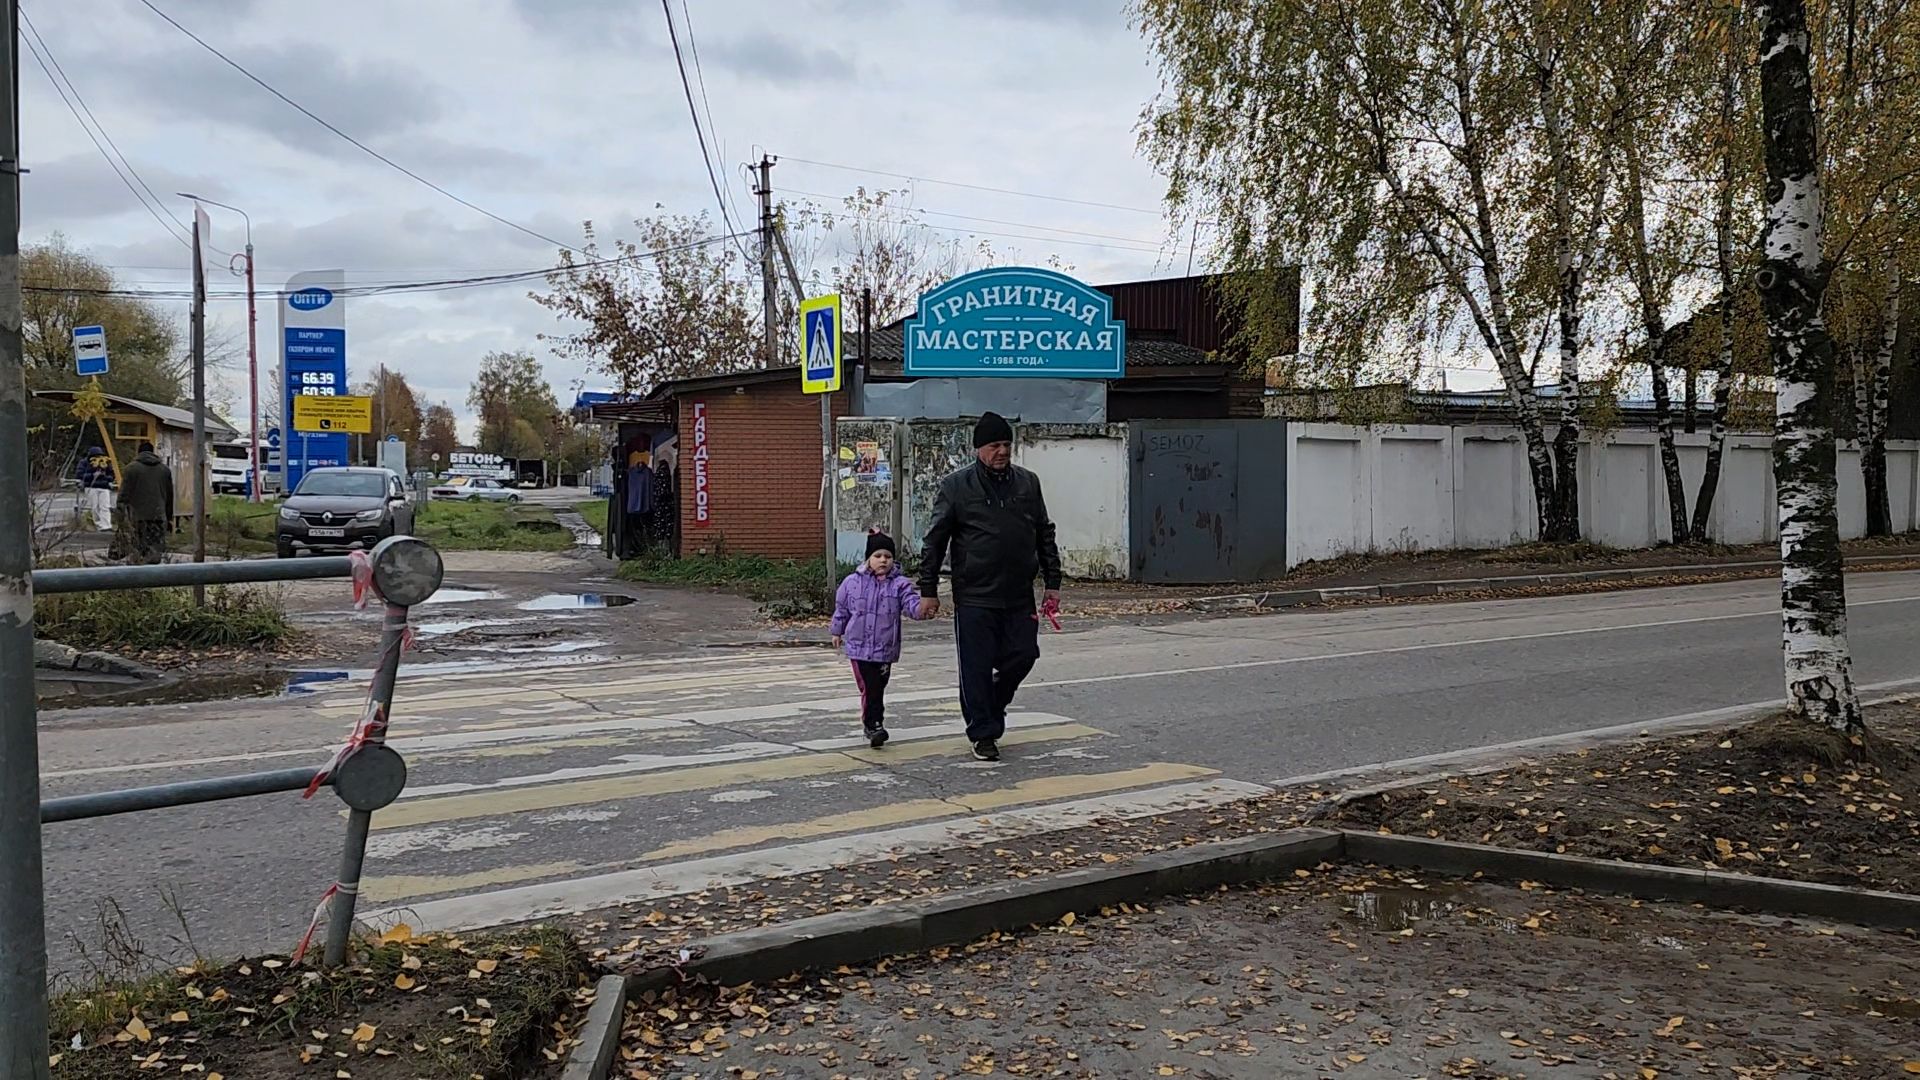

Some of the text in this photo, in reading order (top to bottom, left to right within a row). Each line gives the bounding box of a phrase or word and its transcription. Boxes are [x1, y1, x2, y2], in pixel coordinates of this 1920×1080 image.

[293, 293, 326, 304] ОПТИ
[931, 285, 1100, 327] ГРАНИТНАЯ
[298, 331, 324, 339] ПАРТНЕР
[916, 329, 1113, 351] МАСТЕРСКАЯ
[287, 345, 314, 353] ГАЗПРОМ
[983, 356, 1045, 366] С 1988 ГОДА
[333, 421, 347, 429] 112
[449, 452, 494, 464] БЕТОН
[693, 403, 708, 521] ГАРДЕРОБ
